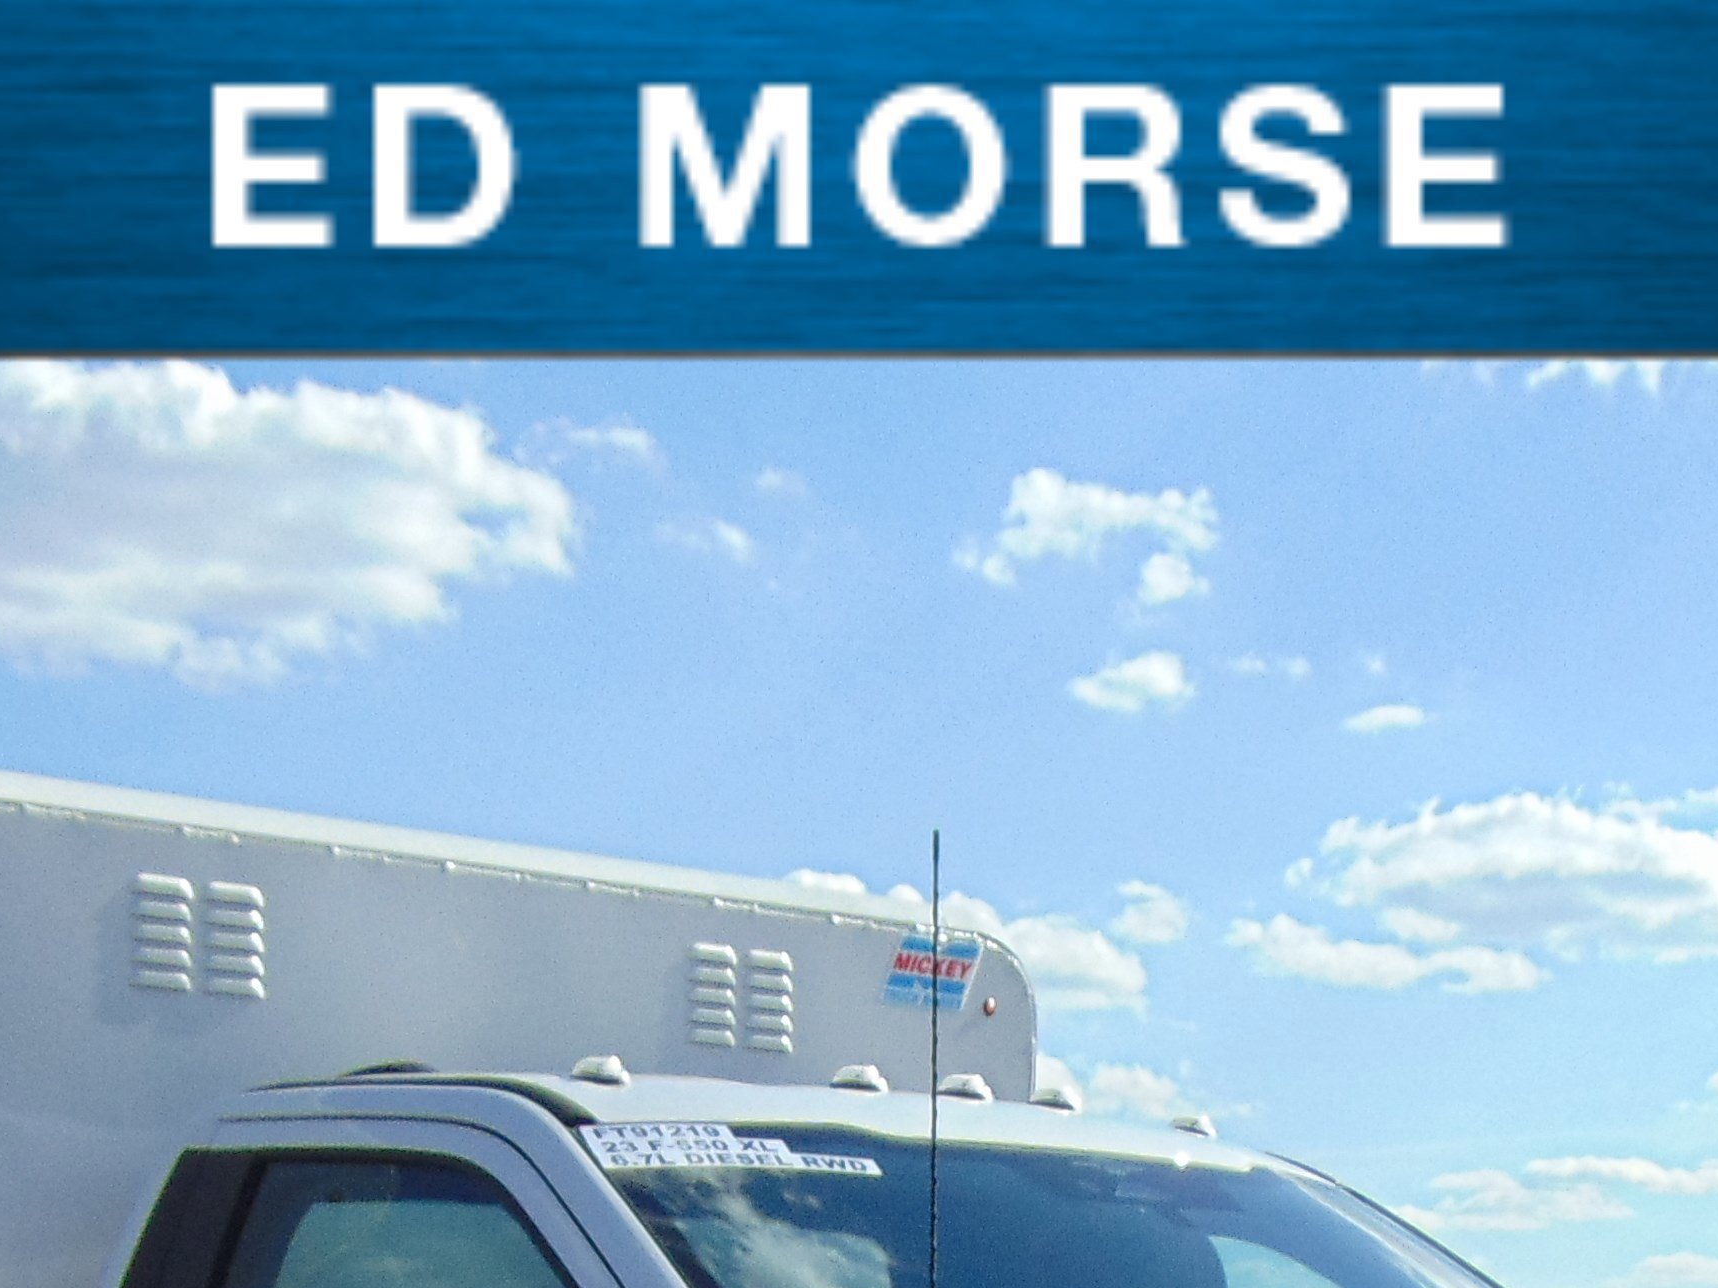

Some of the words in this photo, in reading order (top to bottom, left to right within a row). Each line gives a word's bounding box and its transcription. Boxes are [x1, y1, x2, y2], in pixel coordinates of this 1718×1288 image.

[600, 1140, 639, 1153] 23
[738, 1140, 778, 1152] XL
[610, 1153, 677, 1166] 6.7L
[685, 1153, 794, 1167] DIESEL
[800, 1155, 868, 1171] RWD
